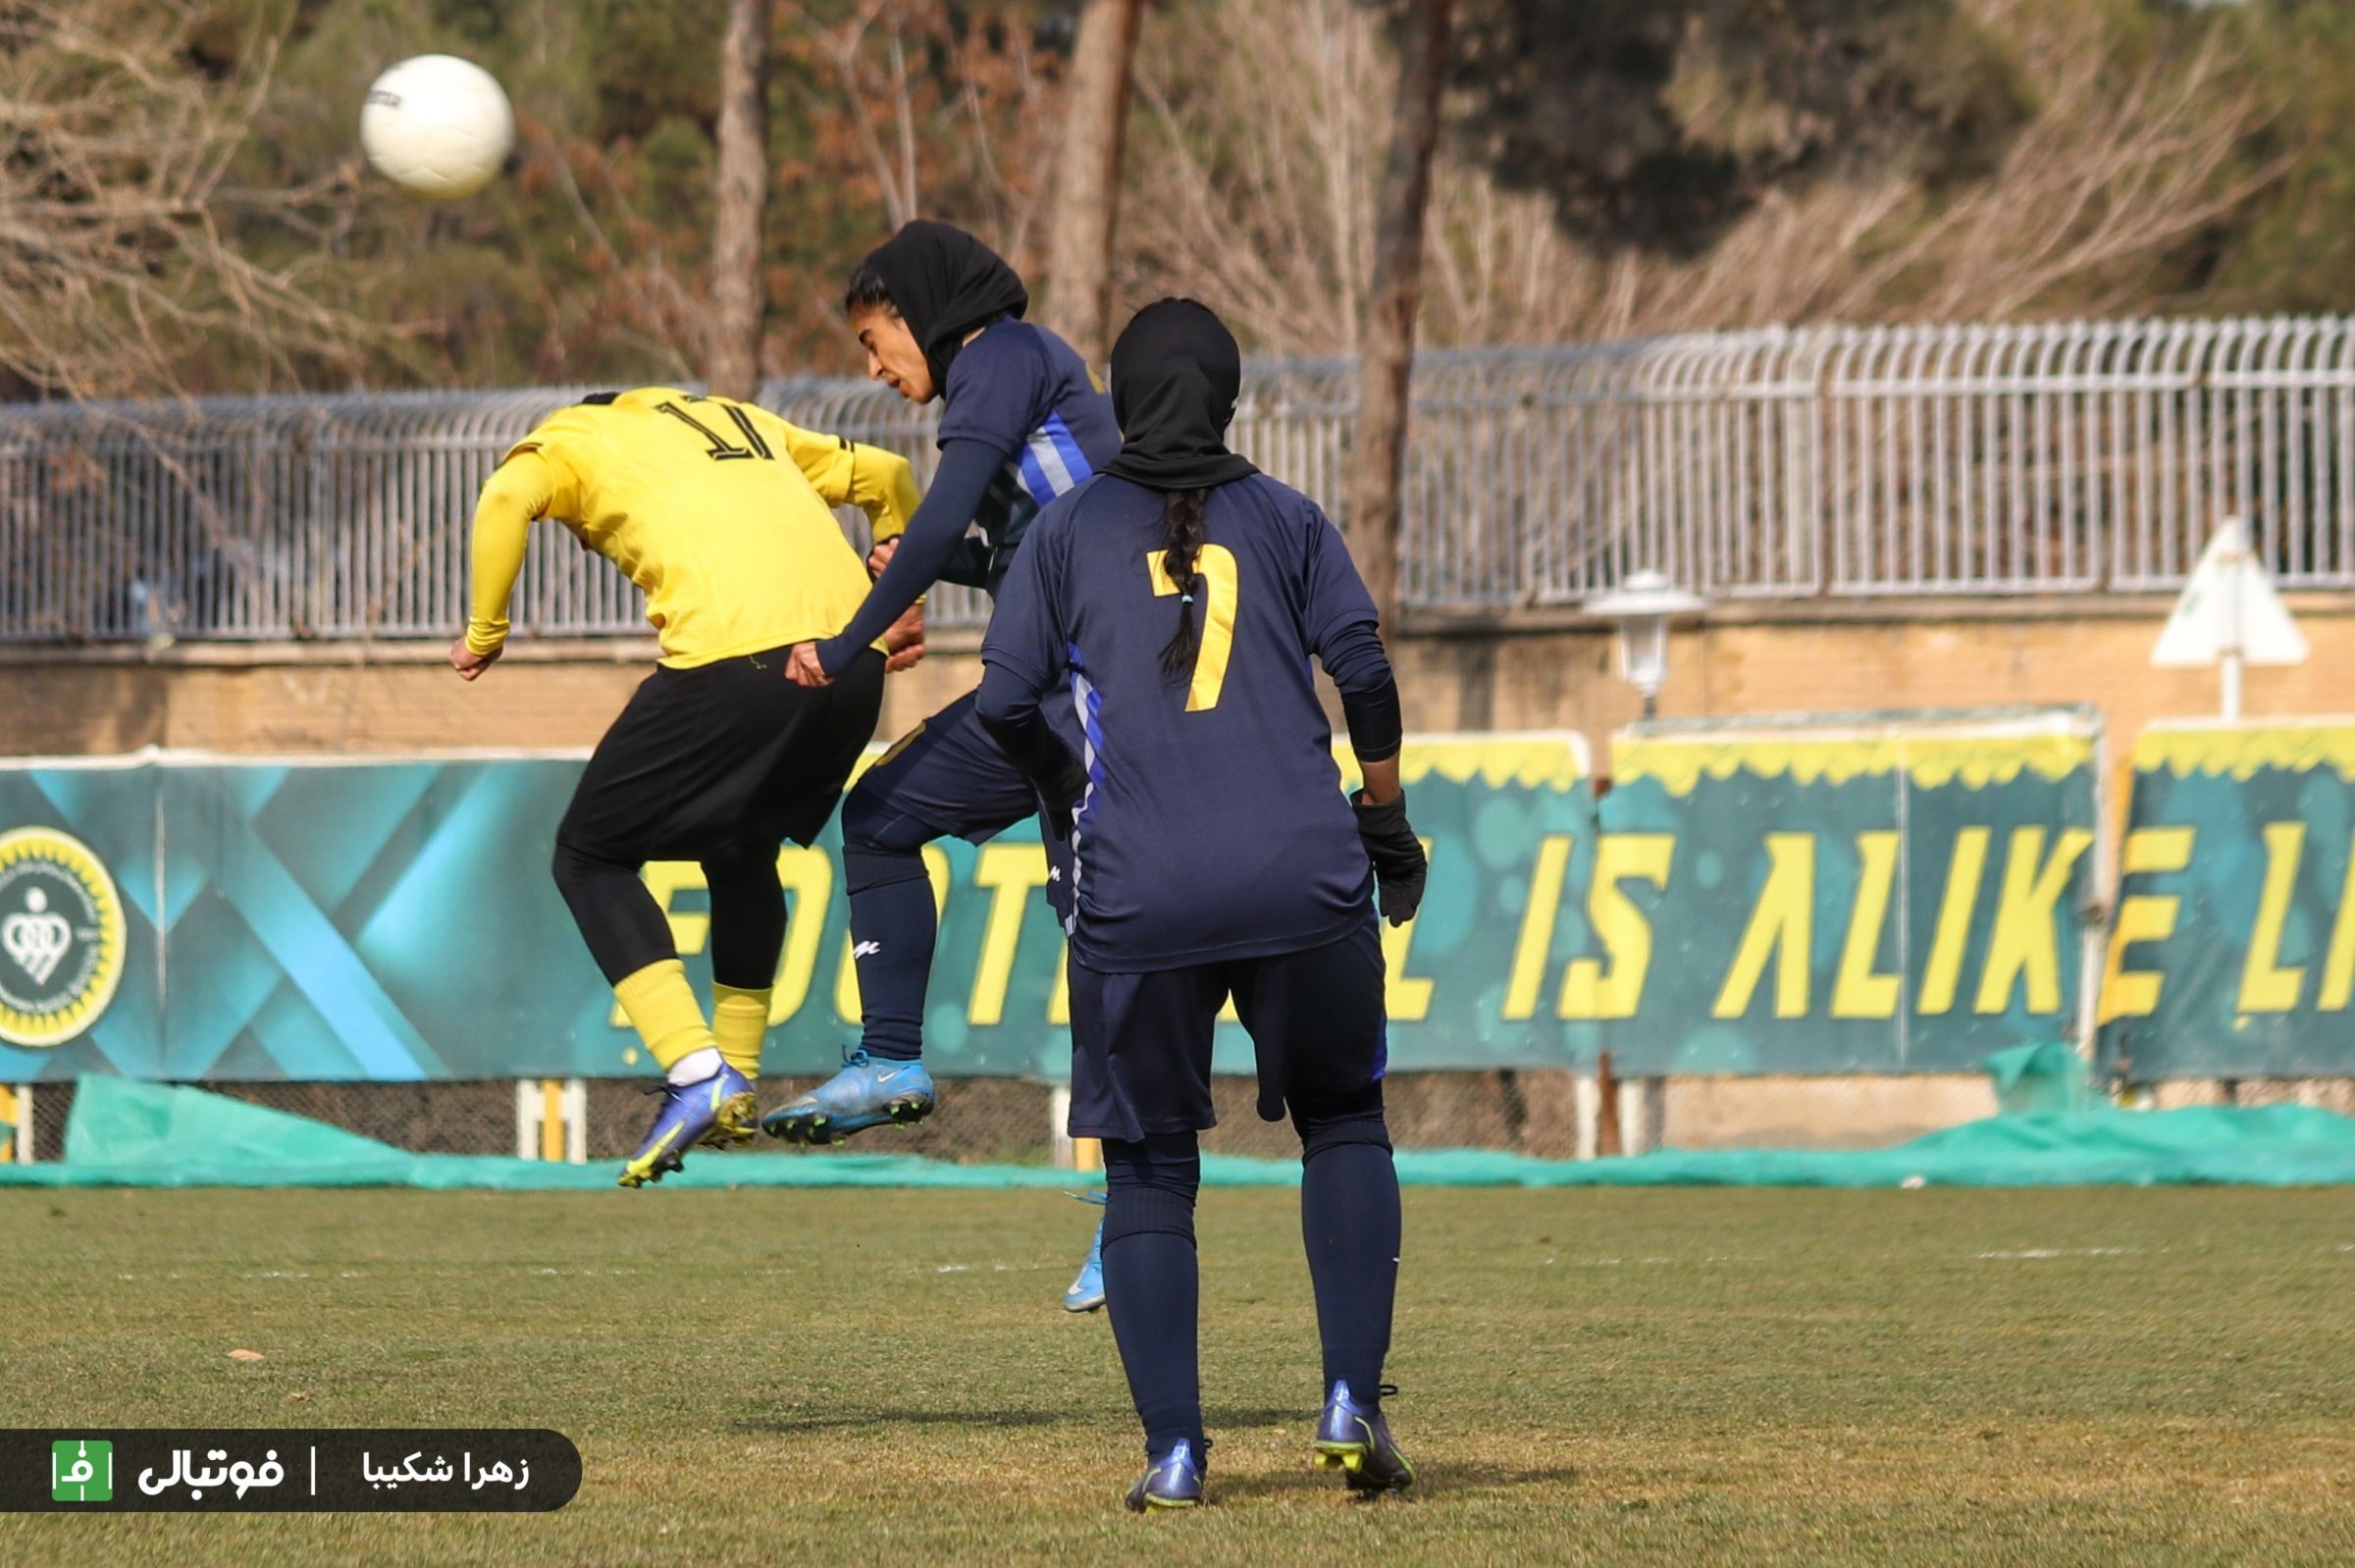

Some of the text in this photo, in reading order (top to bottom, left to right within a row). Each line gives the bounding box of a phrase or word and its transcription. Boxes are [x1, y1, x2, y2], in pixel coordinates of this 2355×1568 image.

[1146, 543, 1238, 712] 7
[1501, 832, 1676, 1020] IS
[1711, 824, 2196, 1027] ALIKE
